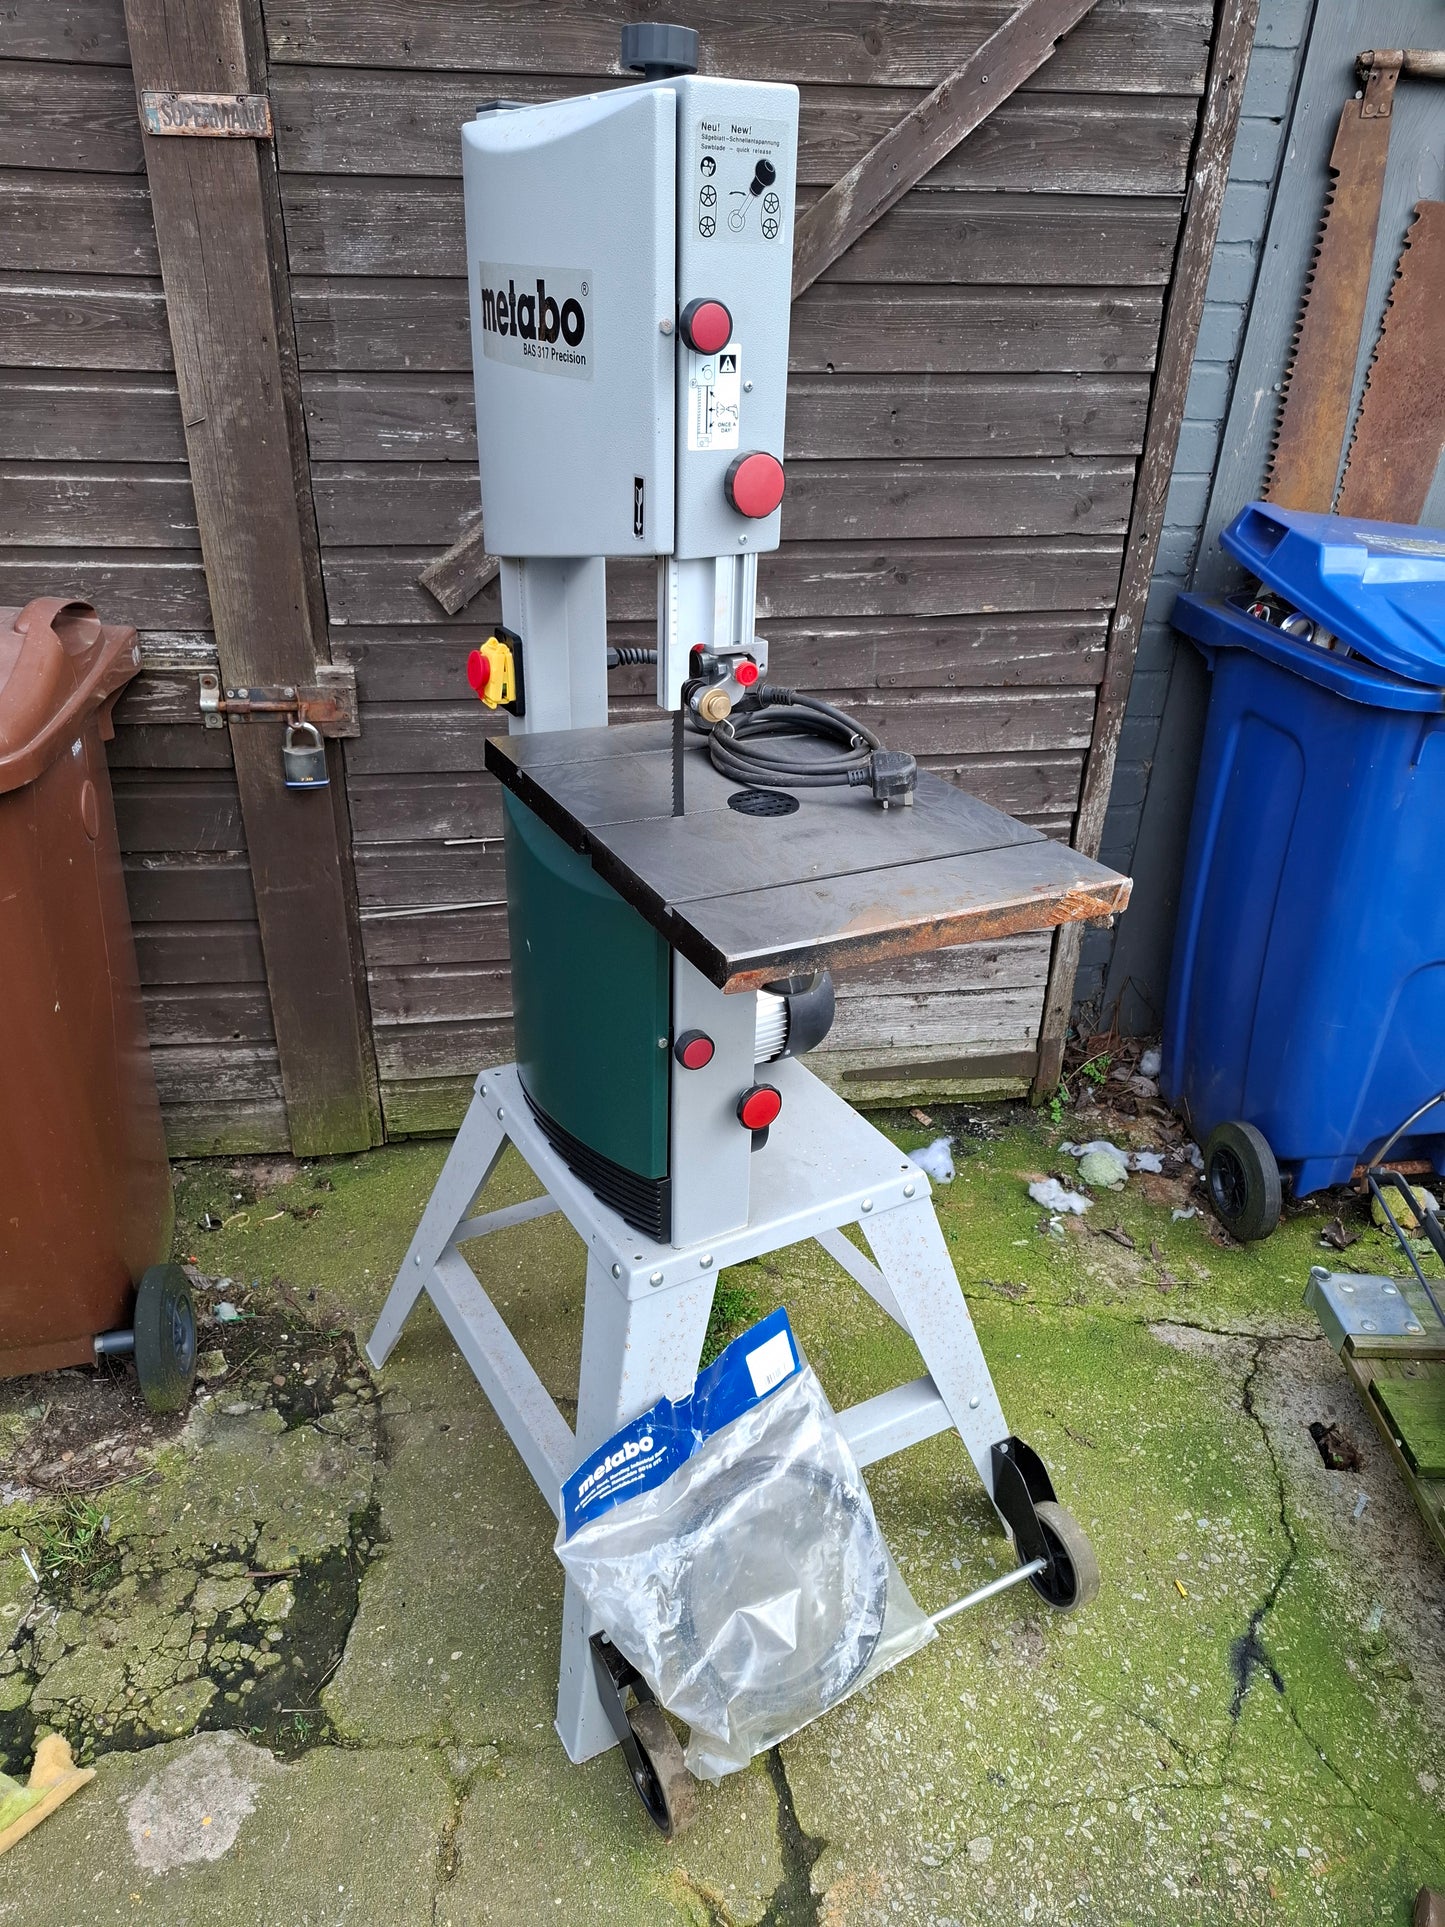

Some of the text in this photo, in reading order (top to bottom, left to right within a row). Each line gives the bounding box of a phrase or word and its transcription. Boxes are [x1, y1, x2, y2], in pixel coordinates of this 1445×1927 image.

[701, 122, 752, 135] Neu! New!
[523, 343, 587, 365] BAS 317 Precision
[578, 1436, 654, 1498] metabo
